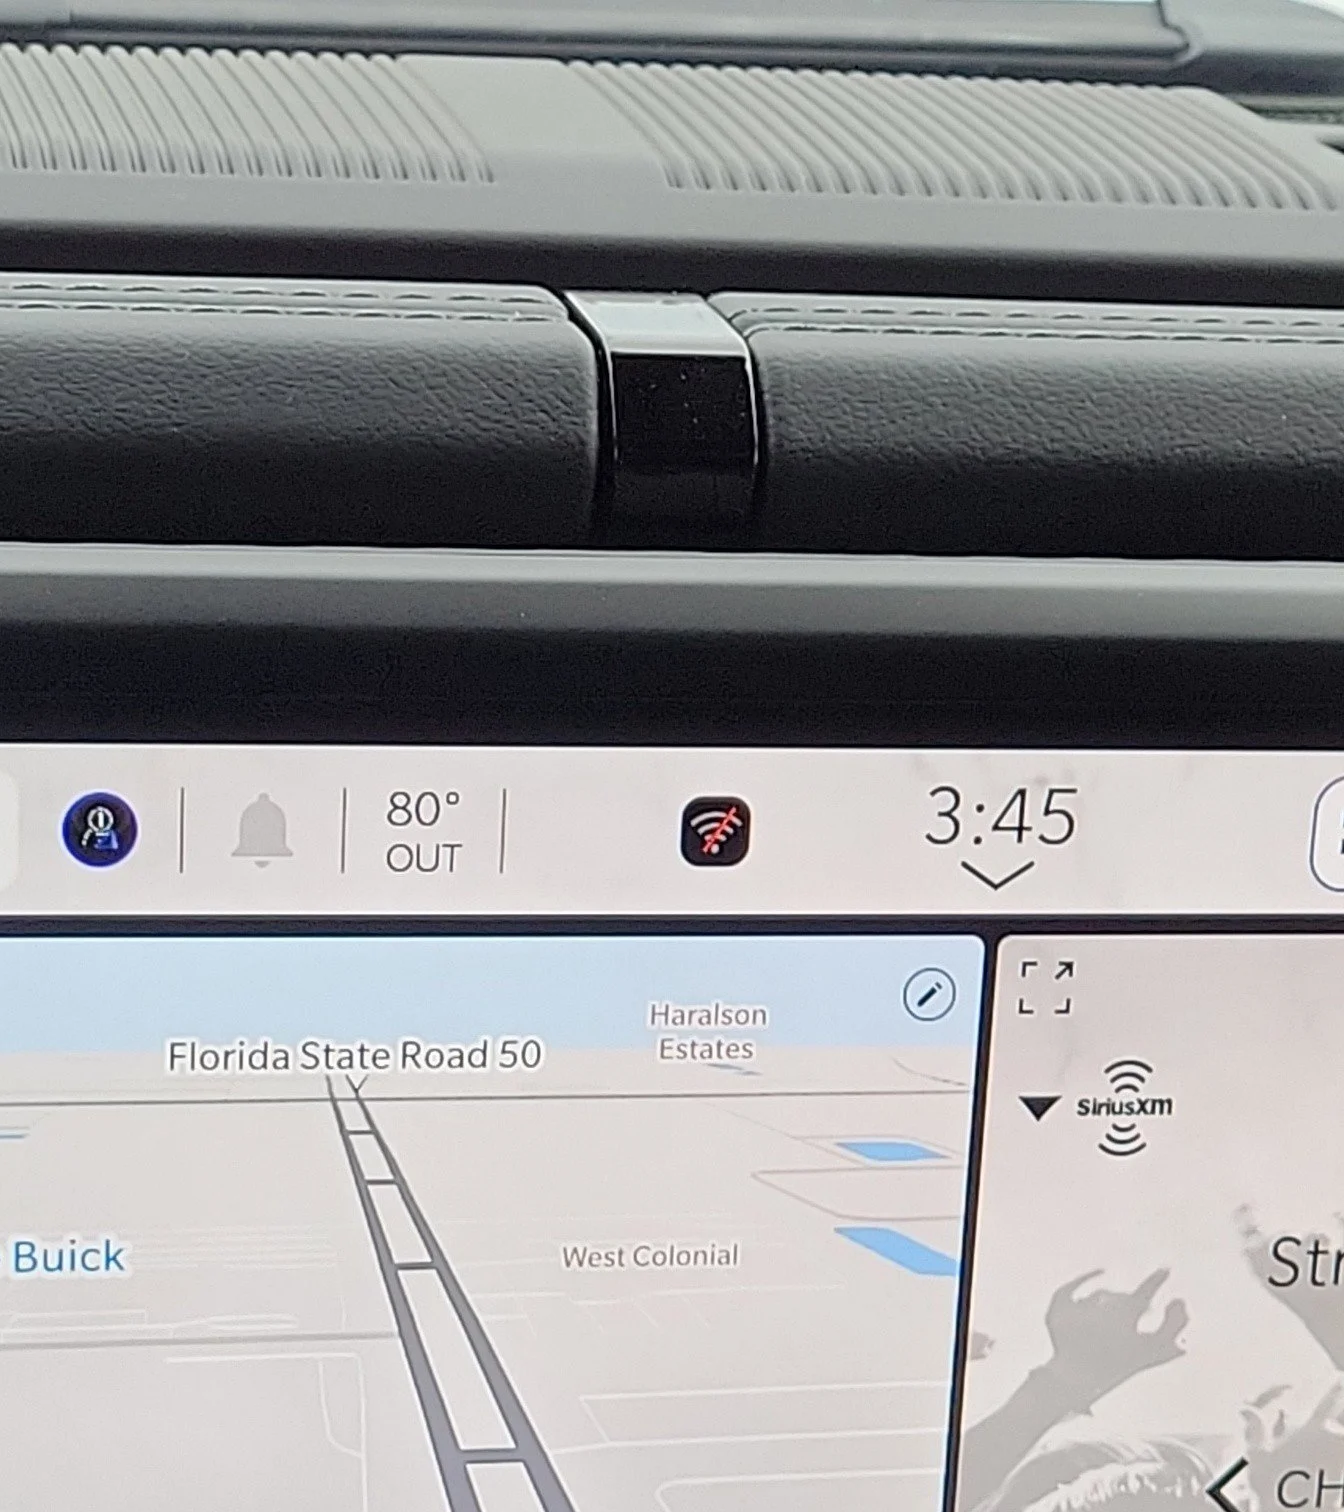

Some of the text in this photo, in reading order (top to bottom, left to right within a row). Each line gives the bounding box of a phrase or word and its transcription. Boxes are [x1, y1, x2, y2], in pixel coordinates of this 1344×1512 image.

[386, 790, 461, 828] 80°
[924, 786, 1078, 847] 3:45
[386, 843, 463, 873] OUT
[649, 1001, 768, 1028] Haralson
[168, 1039, 543, 1073] Florida State Road 50
[659, 1037, 754, 1061] Estates
[12, 1236, 126, 1274] Buick
[562, 1242, 739, 1269] West Colonial
